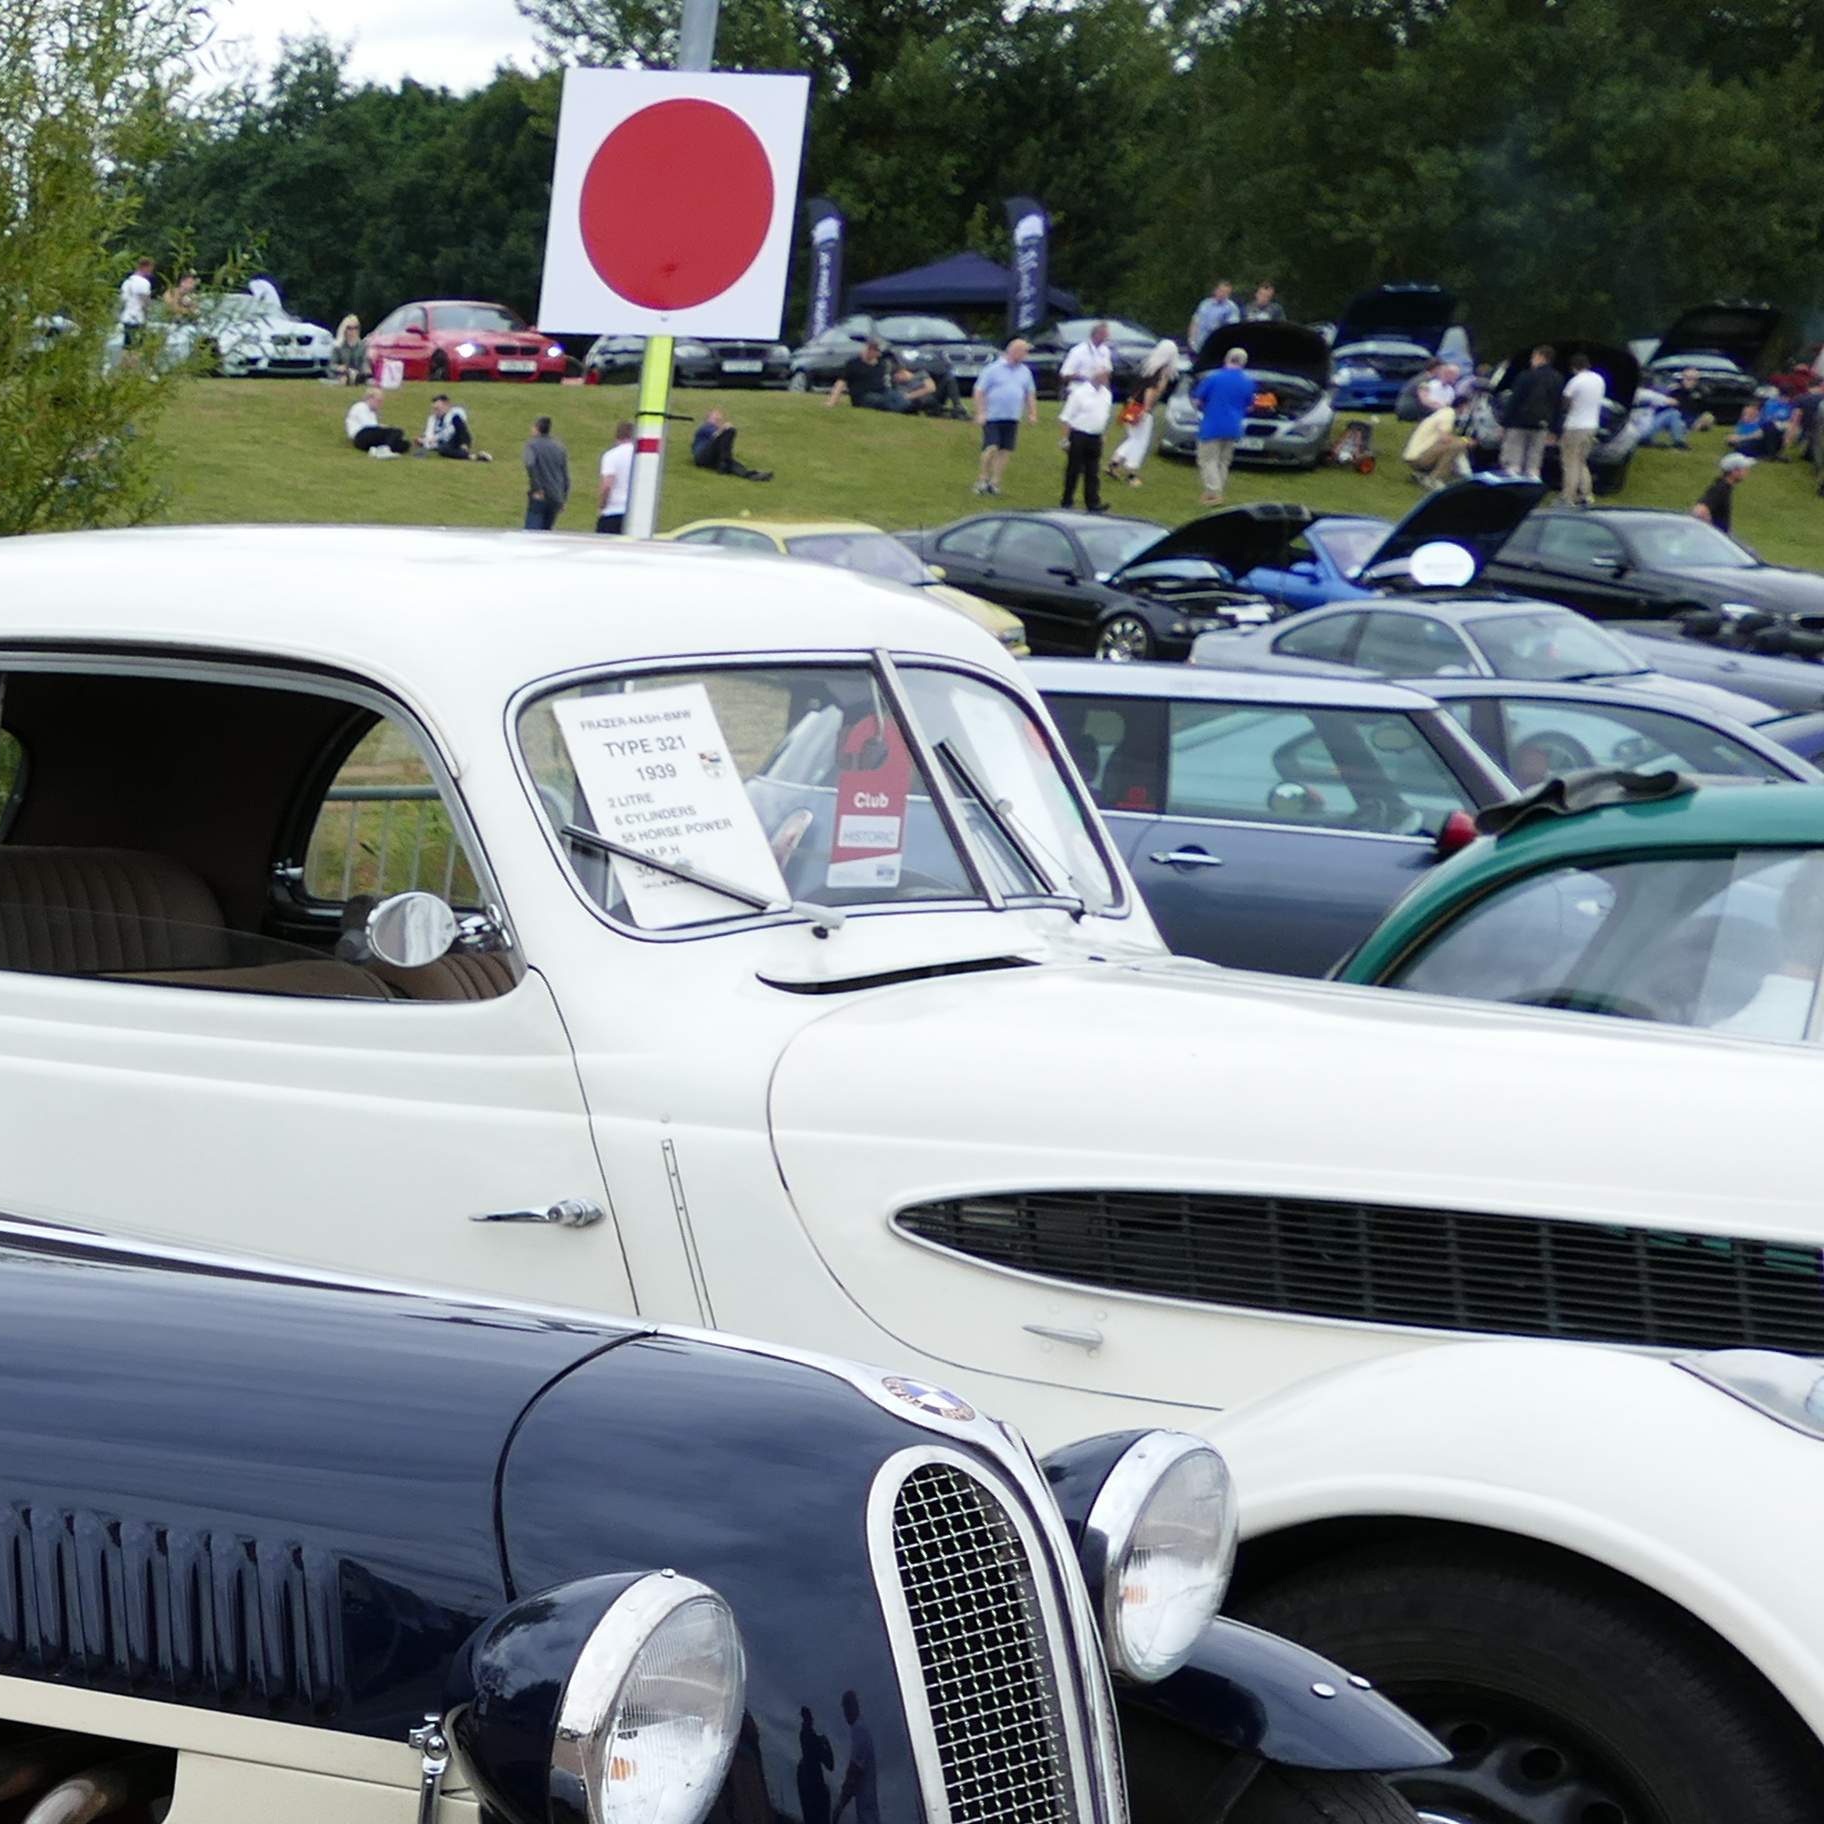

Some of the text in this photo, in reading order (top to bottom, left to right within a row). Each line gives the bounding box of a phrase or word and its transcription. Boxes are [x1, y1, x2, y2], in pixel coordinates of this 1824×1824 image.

[603, 735, 686, 757] TYPE 321
[636, 763, 678, 782] 1939
[618, 792, 655, 808] LITRE
[853, 791, 890, 809] Club
[625, 805, 697, 825] CYLINDERS
[639, 825, 683, 842] HORSE
[685, 818, 734, 834] POWER
[843, 830, 896, 844] HISTORIC
